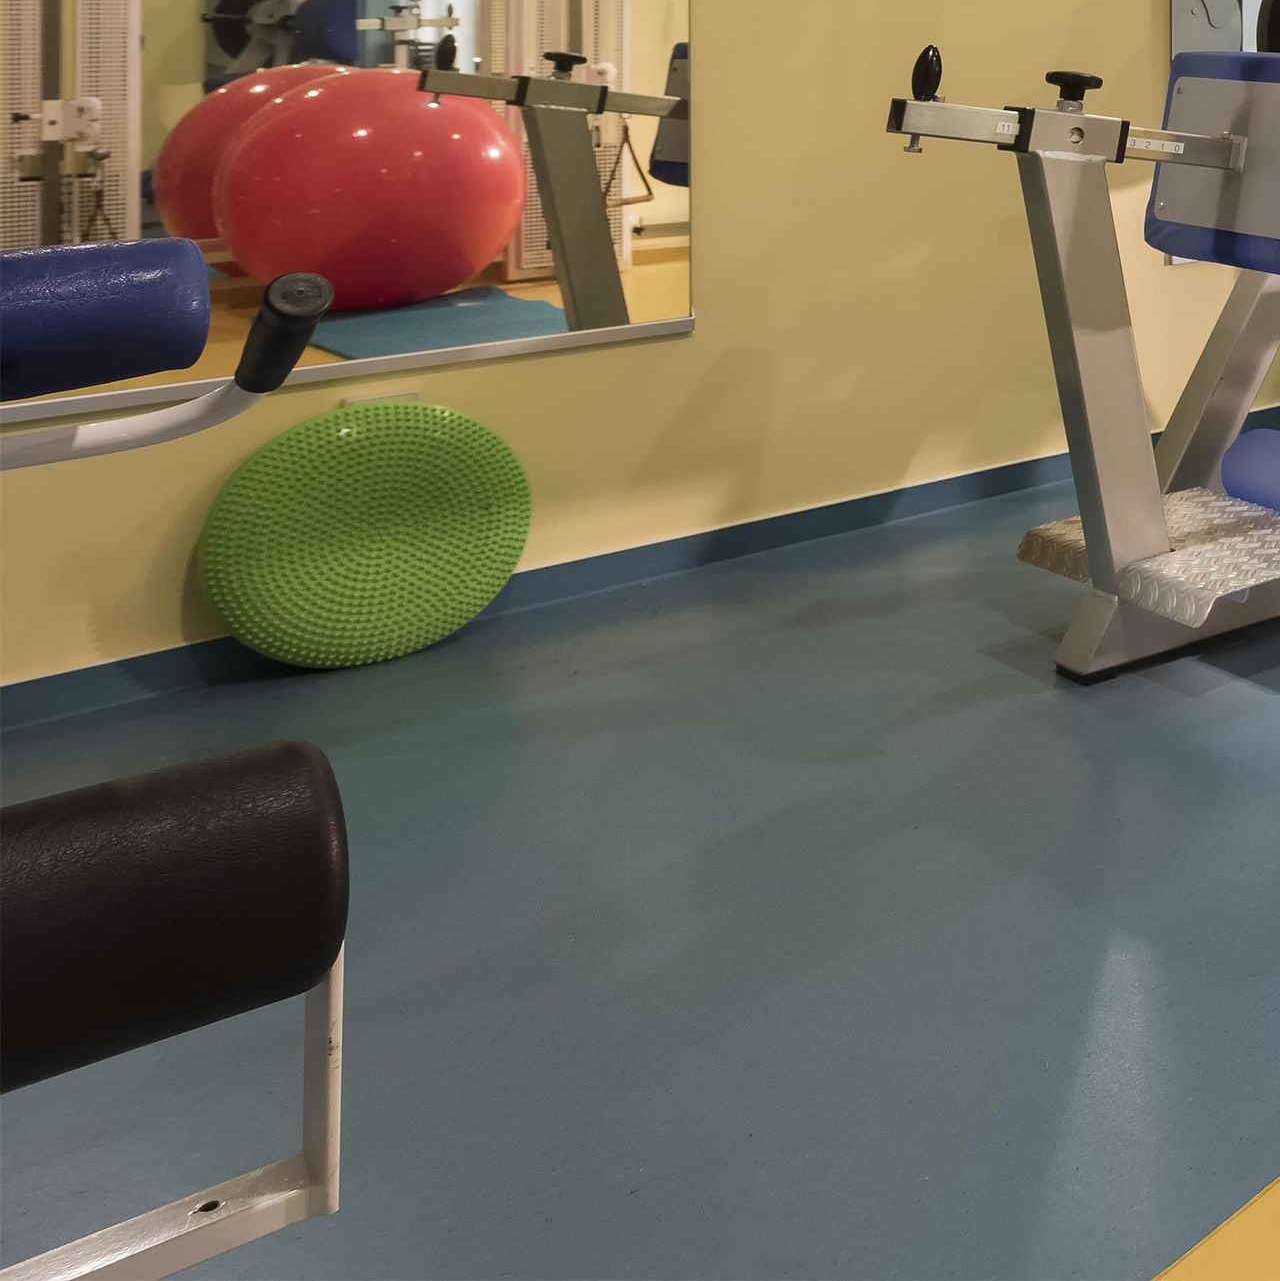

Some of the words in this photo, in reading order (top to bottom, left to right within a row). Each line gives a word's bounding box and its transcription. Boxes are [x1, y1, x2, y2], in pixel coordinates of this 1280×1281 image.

[1130, 139, 1136, 147] 3
[1145, 141, 1151, 149] 2
[1174, 144, 1180, 152] 0
